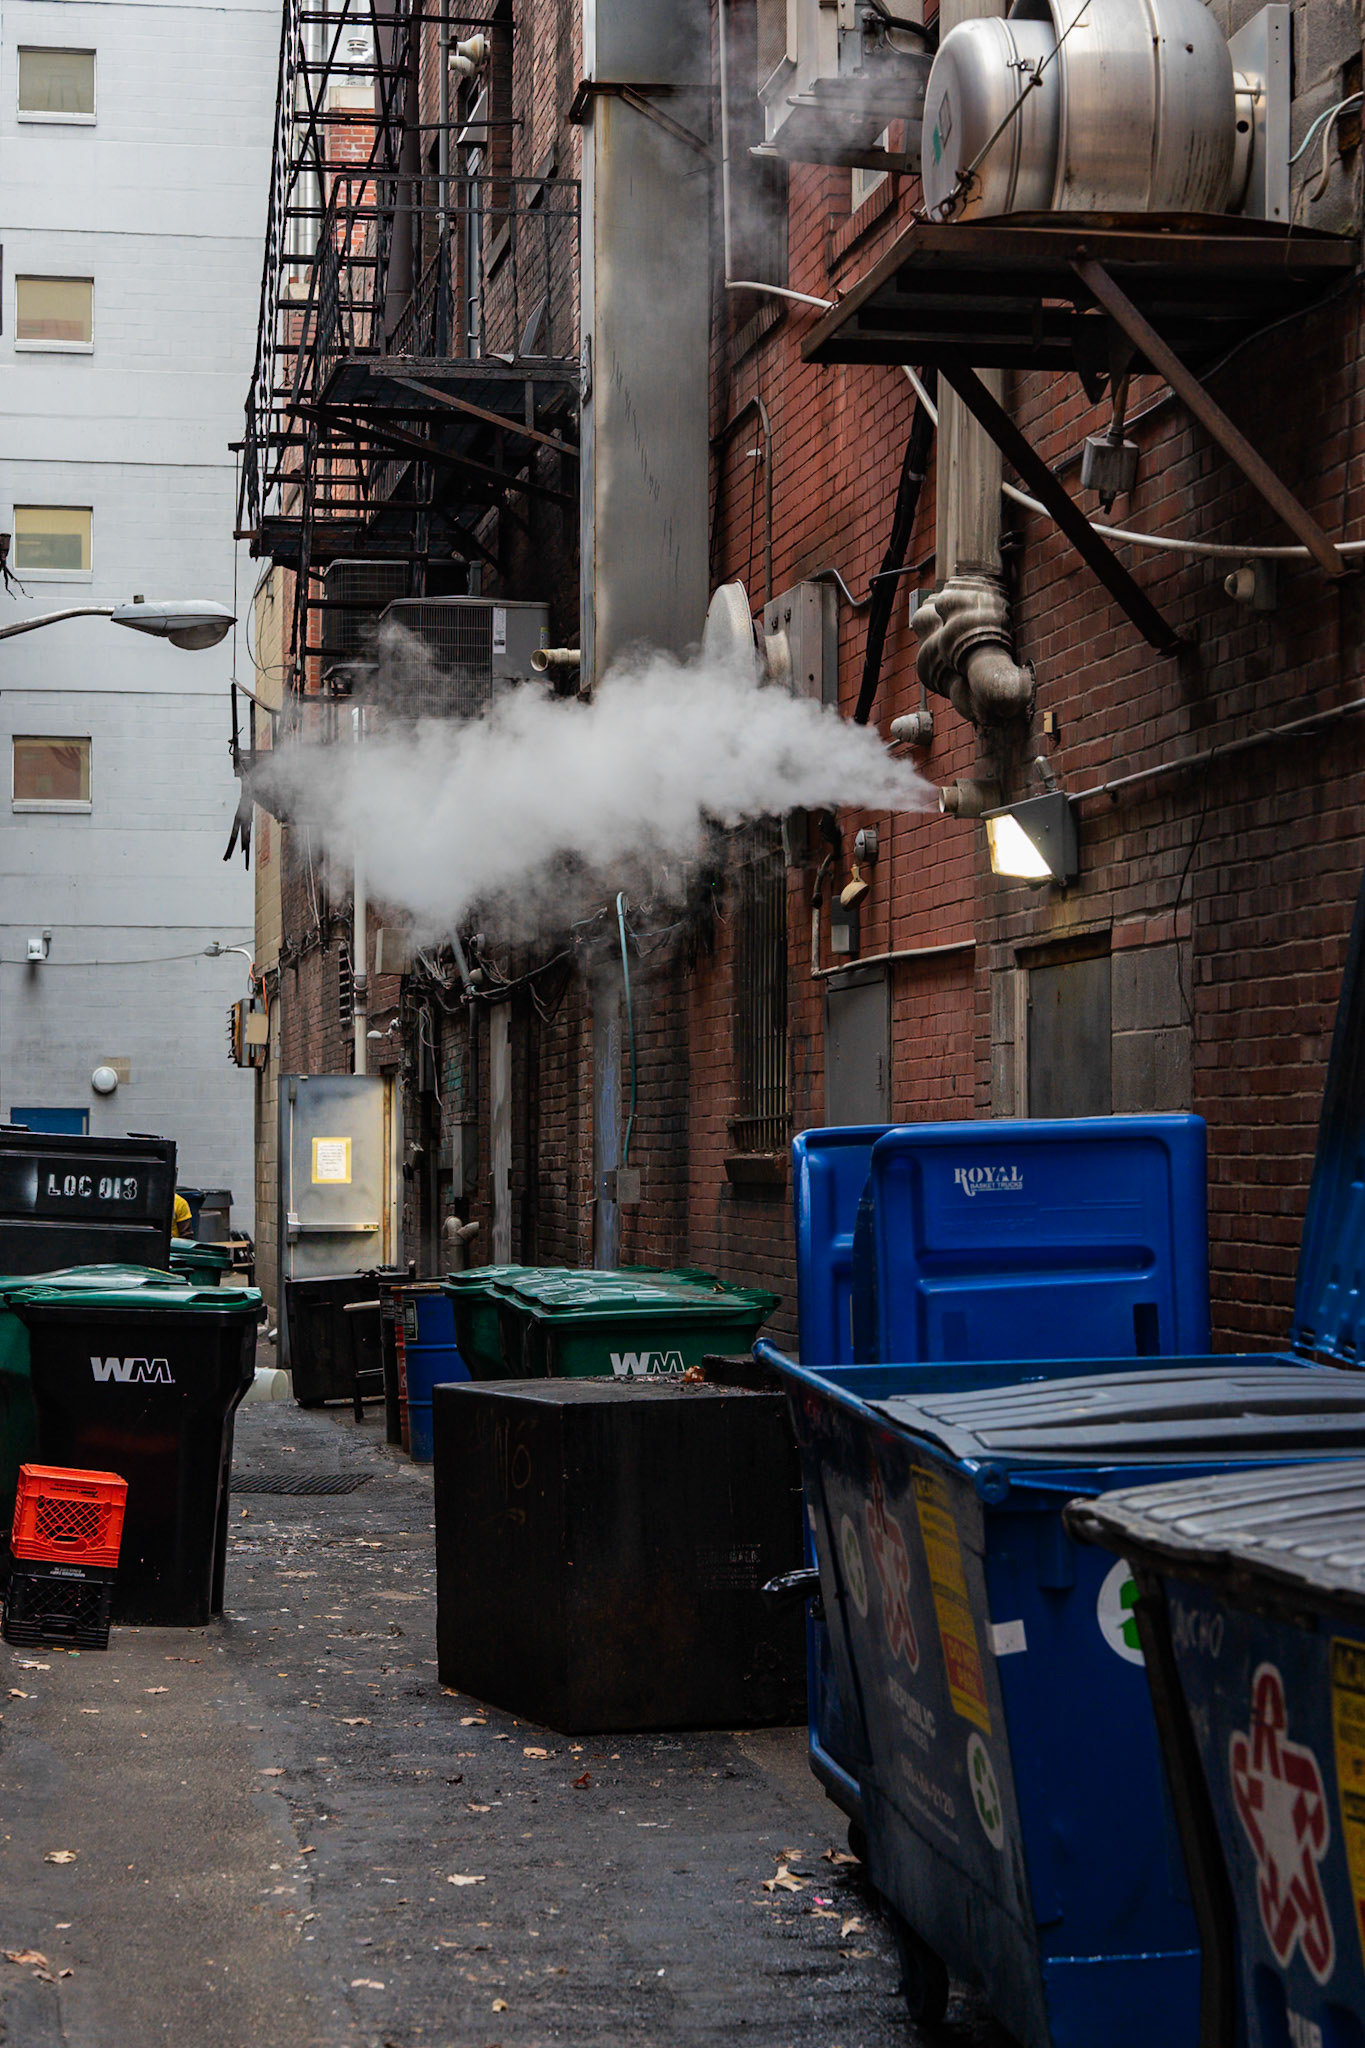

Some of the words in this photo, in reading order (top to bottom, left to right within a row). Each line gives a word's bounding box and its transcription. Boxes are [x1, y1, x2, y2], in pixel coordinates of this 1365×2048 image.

[47, 1173, 92, 1197] LOC
[99, 1177, 138, 1200] 013
[954, 1166, 1023, 1196] ROYAL
[90, 1356, 172, 1383] WM
[609, 1350, 685, 1375] WM
